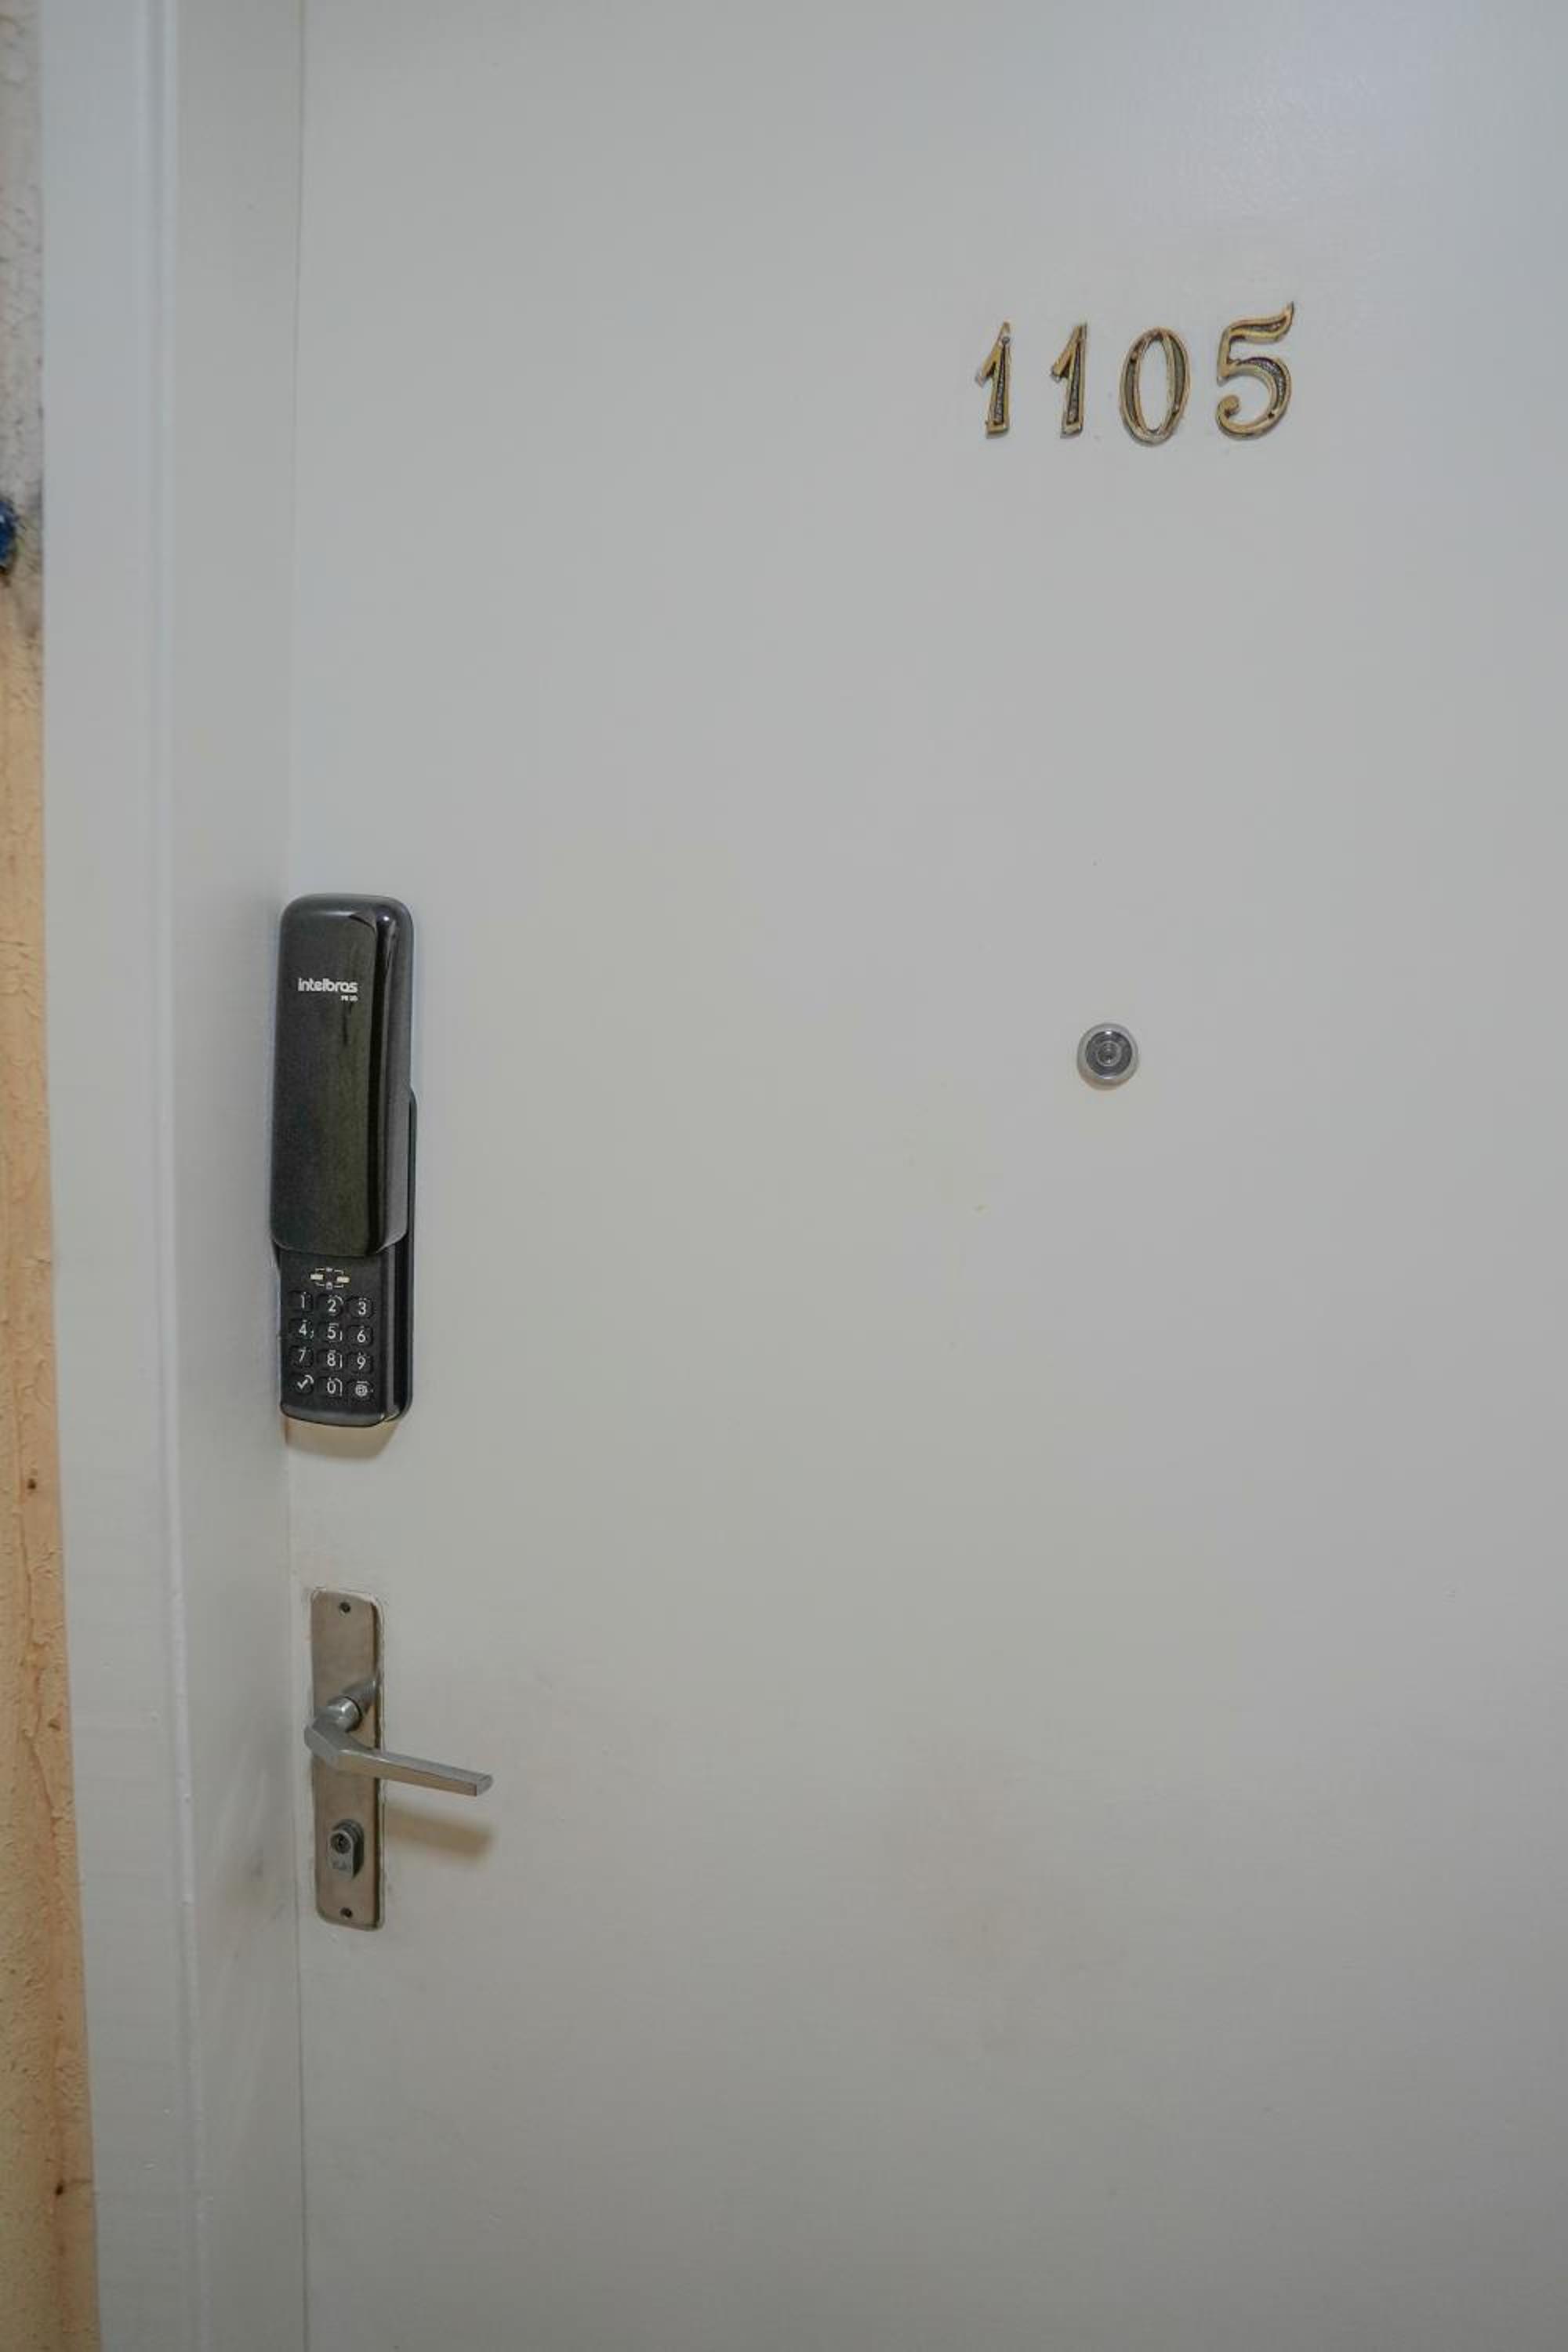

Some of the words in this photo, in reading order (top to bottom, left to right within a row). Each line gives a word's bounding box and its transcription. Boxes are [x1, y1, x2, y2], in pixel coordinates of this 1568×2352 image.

[975, 301, 1294, 445] 1105
[298, 978, 358, 993] intelbras
[327, 1299, 336, 1313] 2
[358, 1301, 366, 1316] 3
[299, 1323, 307, 1336] 4
[327, 1326, 336, 1339] 5
[357, 1330, 366, 1343] 6
[298, 1350, 306, 1363] 7
[327, 1352, 336, 1367] 8
[357, 1356, 366, 1370] 9
[327, 1381, 336, 1394] 0
